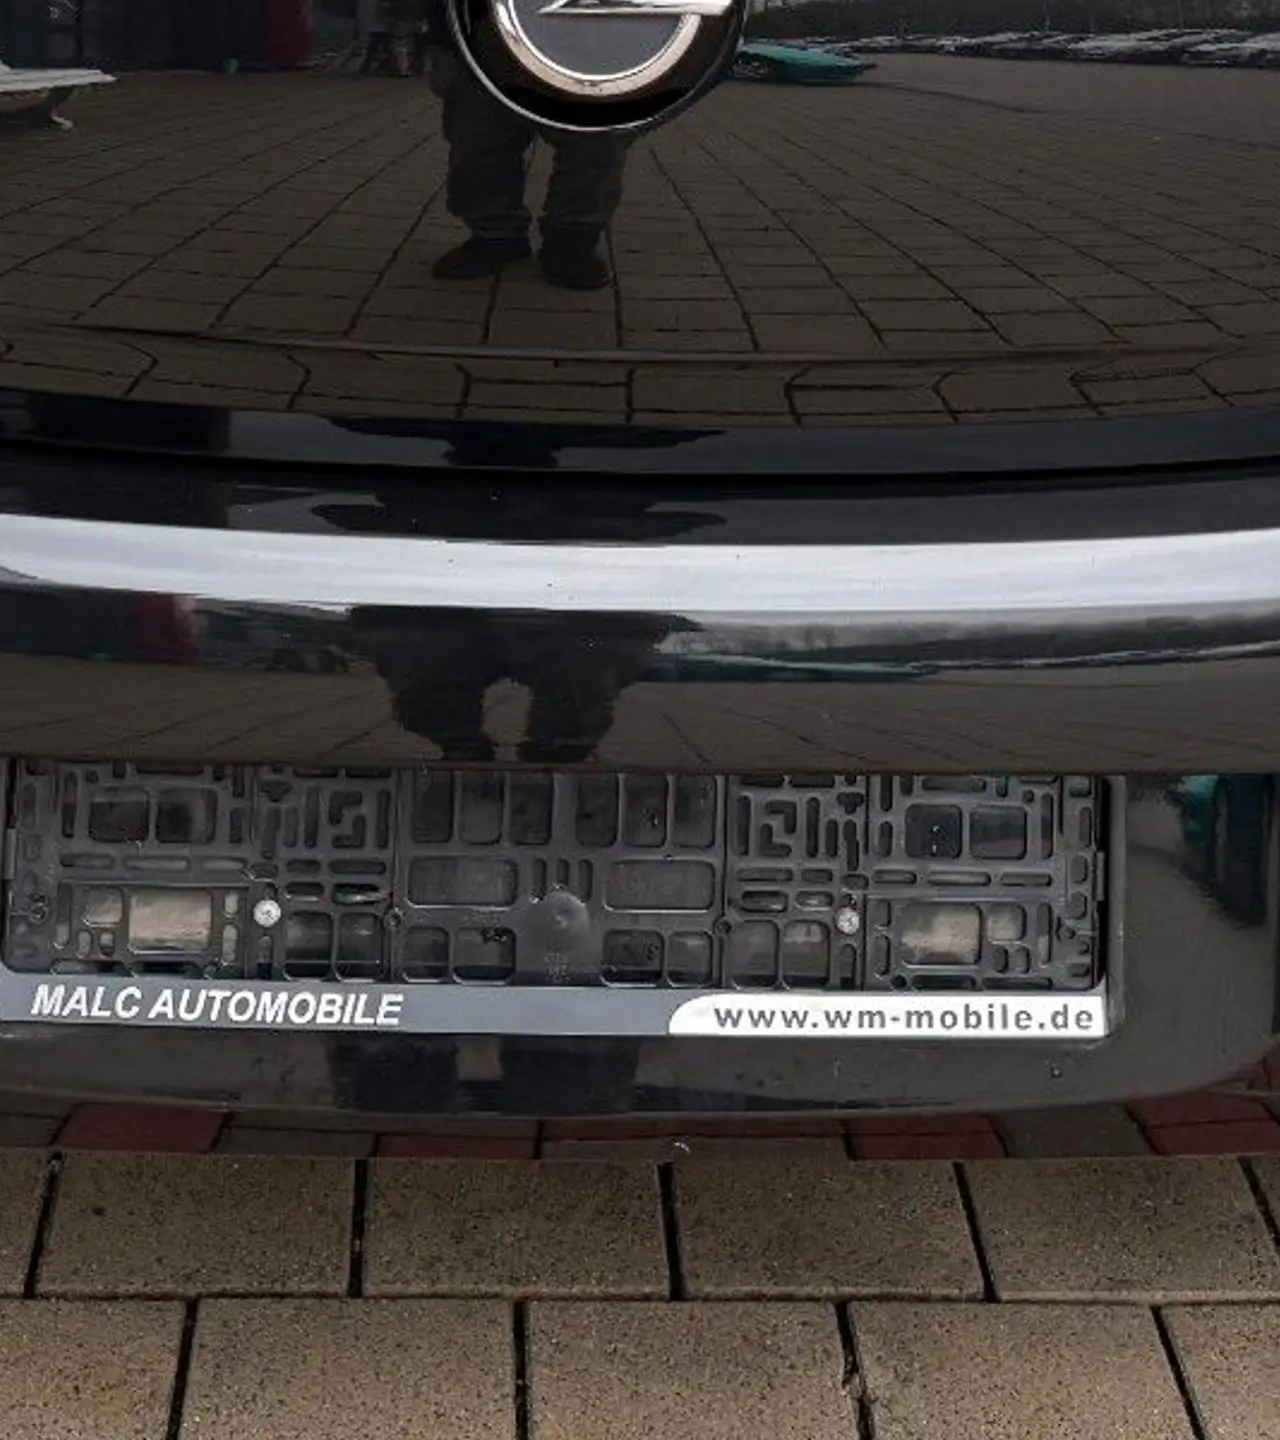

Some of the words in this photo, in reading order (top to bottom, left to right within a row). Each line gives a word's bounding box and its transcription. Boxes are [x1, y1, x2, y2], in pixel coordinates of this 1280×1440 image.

[30, 983, 142, 1019] MALC
[147, 988, 404, 1026] AUTOMOBILE
[714, 1003, 1094, 1030] www.wm-mobile.de
